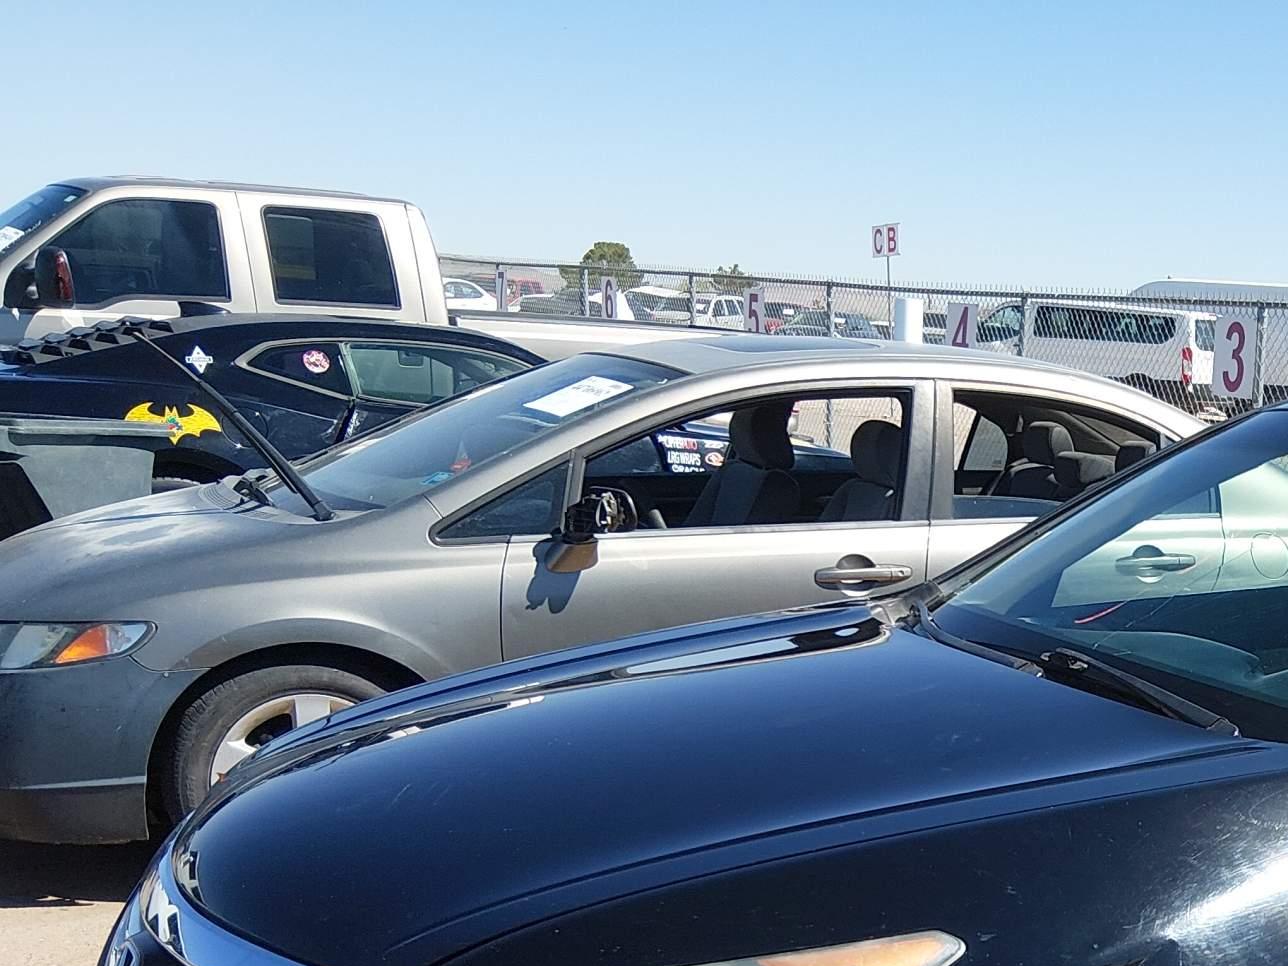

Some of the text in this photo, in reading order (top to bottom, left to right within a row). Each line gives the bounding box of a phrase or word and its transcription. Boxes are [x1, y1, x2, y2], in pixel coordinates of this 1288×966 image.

[873, 227, 897, 254] C B
[605, 279, 614, 318] 6
[748, 293, 760, 333] 5
[952, 306, 969, 348] 4
[1222, 321, 1246, 392] 3
